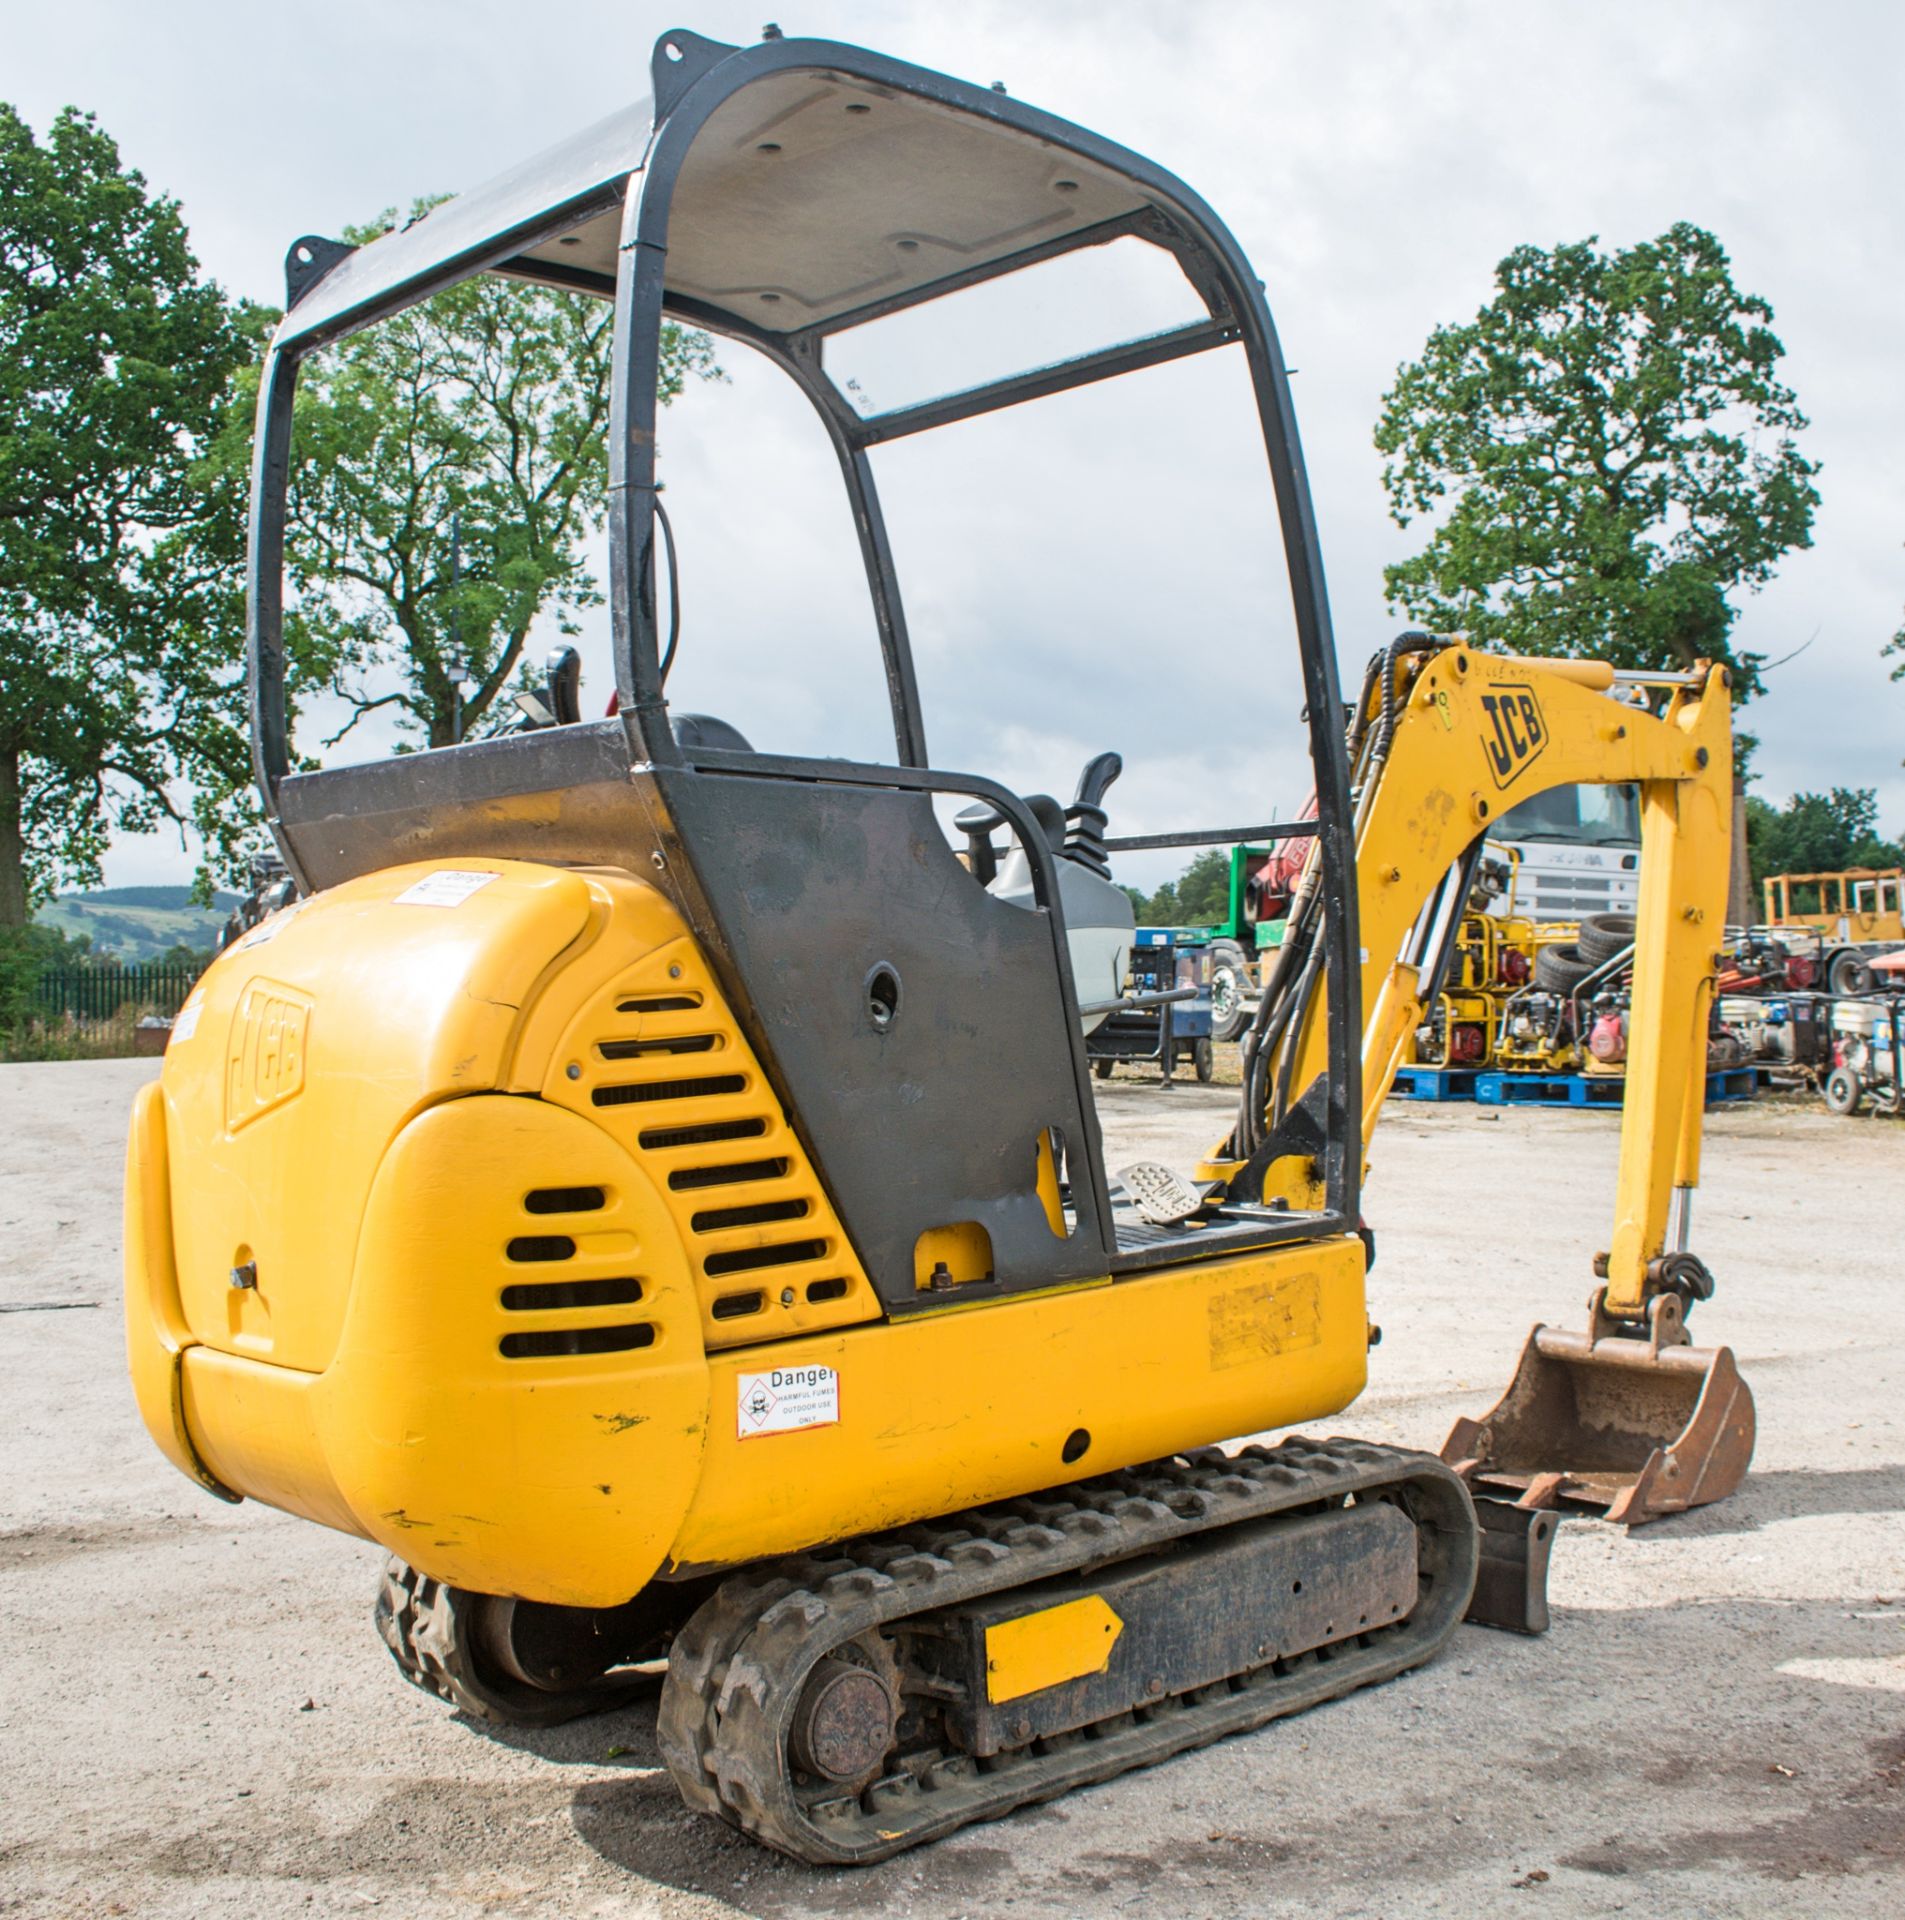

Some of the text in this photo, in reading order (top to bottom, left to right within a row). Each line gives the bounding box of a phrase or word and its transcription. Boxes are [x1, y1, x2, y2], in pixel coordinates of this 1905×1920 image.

[1481, 694, 1542, 776] JCB
[230, 990, 303, 1122] JCB
[812, 1387, 835, 1397] FUMES
[783, 1400, 832, 1415] OUTDOOR USE
[798, 1416, 817, 1424] ONLY
